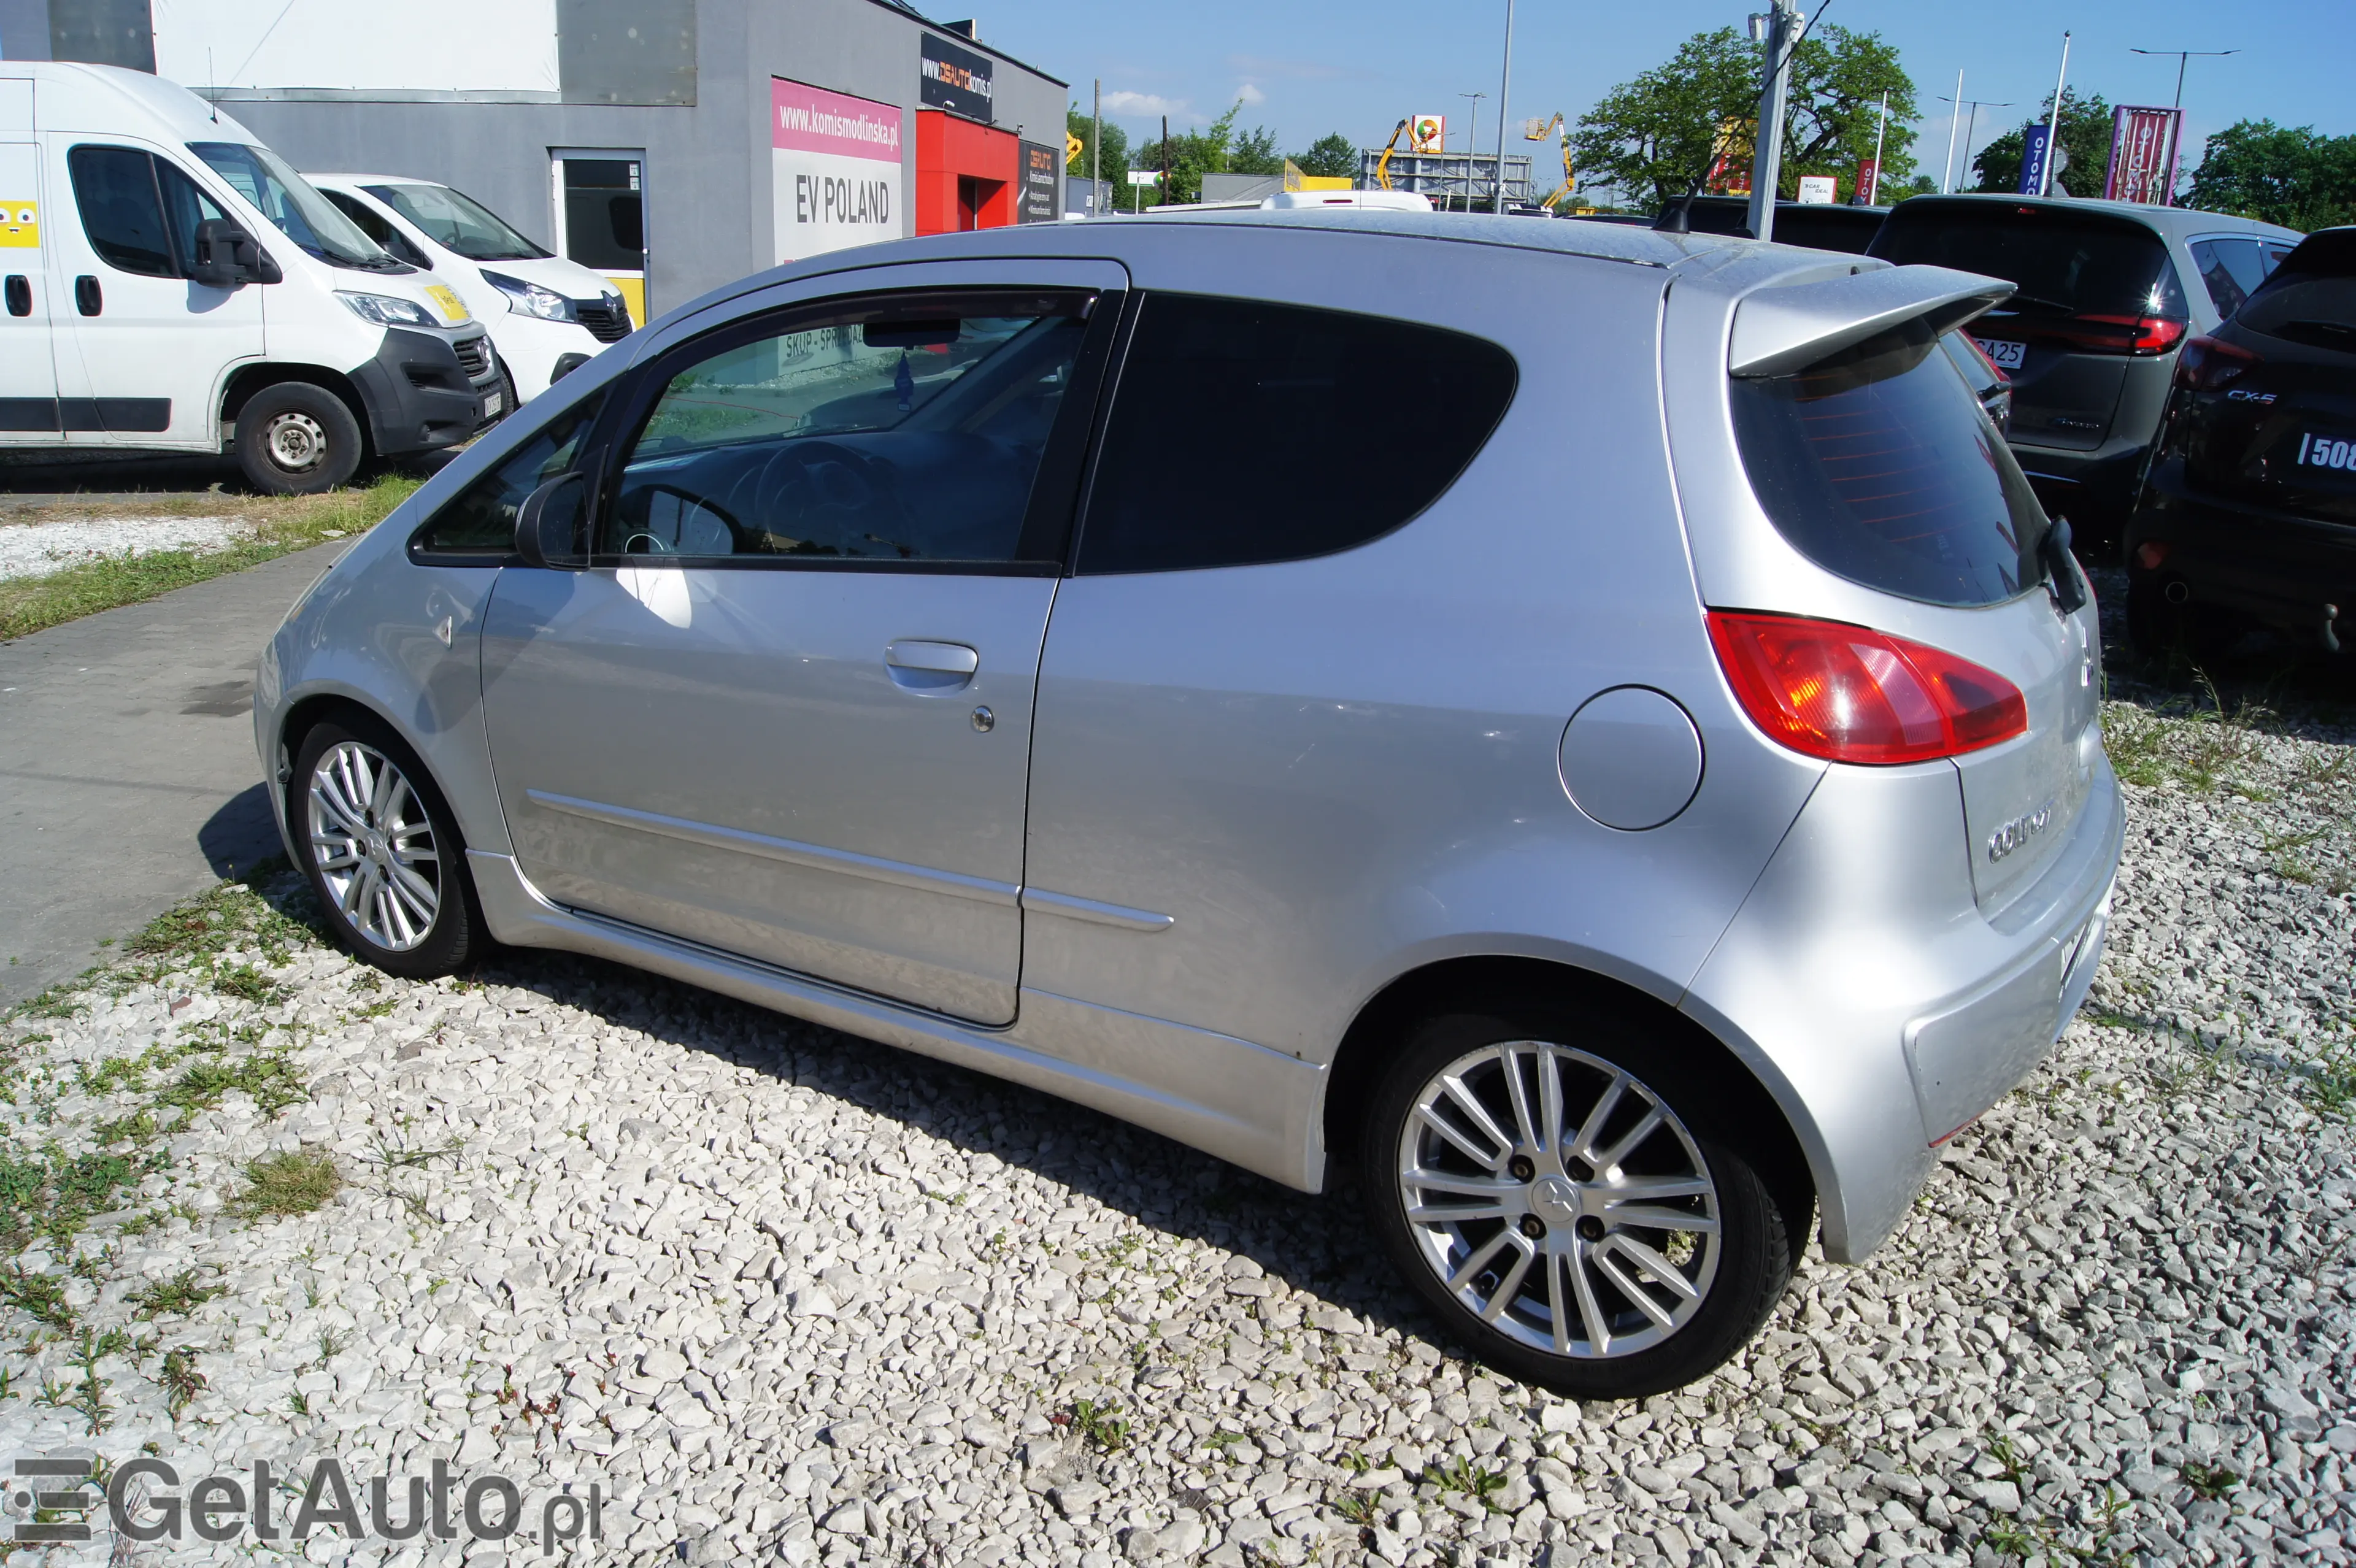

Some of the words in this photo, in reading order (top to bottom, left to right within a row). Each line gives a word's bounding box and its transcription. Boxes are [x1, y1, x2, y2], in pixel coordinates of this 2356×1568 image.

[780, 104, 898, 152] www.komismodlinska.pl
[796, 174, 819, 223] EV
[825, 177, 888, 224] POLAND
[787, 332, 812, 358] SKUP
[2228, 390, 2277, 405] CX-5
